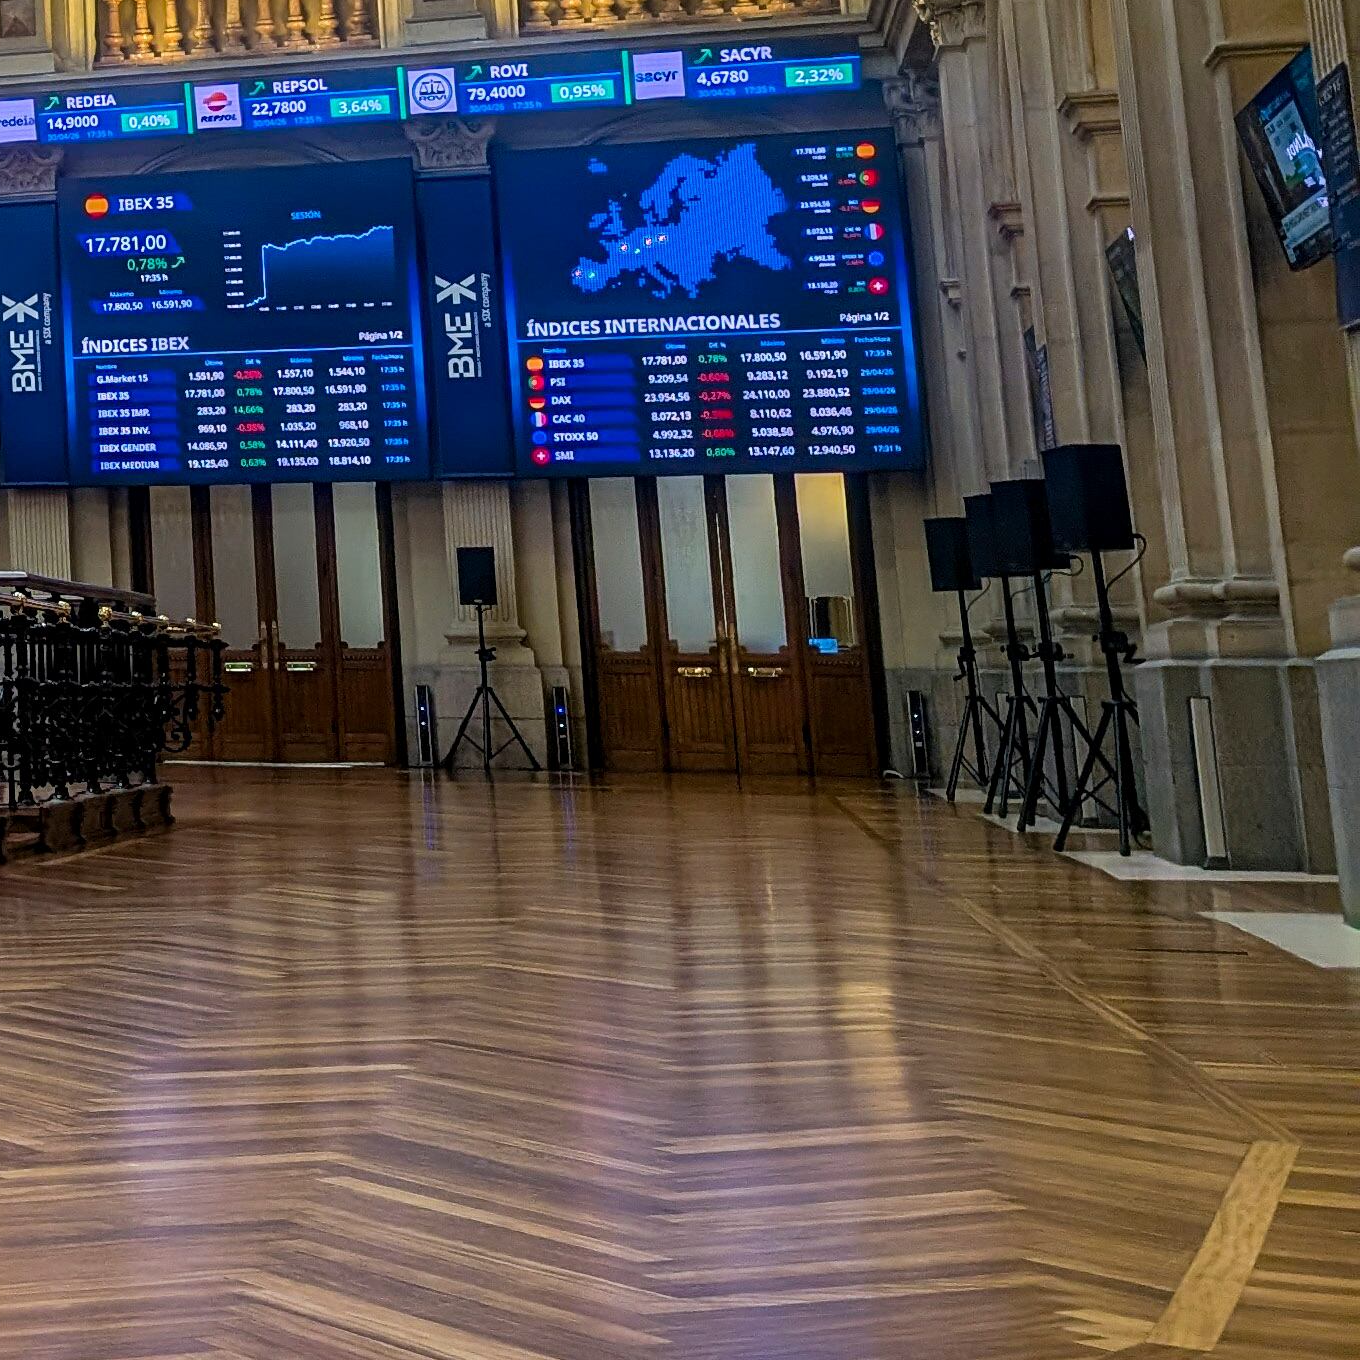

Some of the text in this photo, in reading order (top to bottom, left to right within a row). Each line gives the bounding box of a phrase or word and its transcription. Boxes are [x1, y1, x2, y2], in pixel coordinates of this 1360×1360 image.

[720, 46, 773, 63] SACYR
[489, 63, 529, 80] ROVI
[635, 69, 679, 85] sacyr
[696, 66, 845, 86] 4,6780 2,32%
[271, 77, 328, 95] REPSOL
[466, 82, 606, 102] 79,4000 0,95%
[66, 94, 116, 111] REDEIA
[418, 92, 448, 103] ROVI
[251, 97, 383, 117] 22,7800 3,64%
[46, 113, 171, 131] 14,9000 0,40%
[200, 113, 238, 125] REPSOL
[118, 195, 175, 213] IBEX 35
[290, 209, 322, 221] SESIÓN
[85, 233, 167, 254] 17.781,00
[126, 256, 168, 273] 0,78%
[140, 273, 161, 284] 17:35
[101, 298, 193, 313] 17.800,50 16.591,90
[526, 313, 781, 337] ÍNDICES INTERNACIONALES
[839, 311, 890, 325] Página 1/2
[81, 336, 190, 354] ÍNDICES IBEX
[358, 330, 403, 343] Página 1/2
[445, 312, 476, 379] BME
[9, 329, 37, 393] BME
[548, 349, 848, 369] IBEX 35 17.781,00 17.800,50 16.591,90
[96, 367, 366, 384] G.Market 15 1.544,10
[550, 368, 849, 387] PSI 9.209,54 9.192,19
[97, 392, 118, 401] IBEX
[551, 395, 572, 405] DAX
[742, 389, 791, 401] 24.110,00
[98, 409, 118, 418] IBEX
[552, 408, 793, 424] CAC 40 8.072,13 8.110,62
[98, 427, 119, 436] IBEX
[132, 426, 151, 435] INV.
[280, 422, 317, 432] 1.035,20
[553, 425, 855, 442] STOXX 50 4.992,32 4.976,90
[99, 444, 120, 453] IBEX
[120, 443, 157, 452] GENDER
[555, 450, 575, 461] SMI
[748, 445, 796, 457] 13.147,60
[807, 444, 857, 456] 12.940,50
[100, 461, 121, 470] IBEX
[121, 460, 160, 470] MEDIUM
